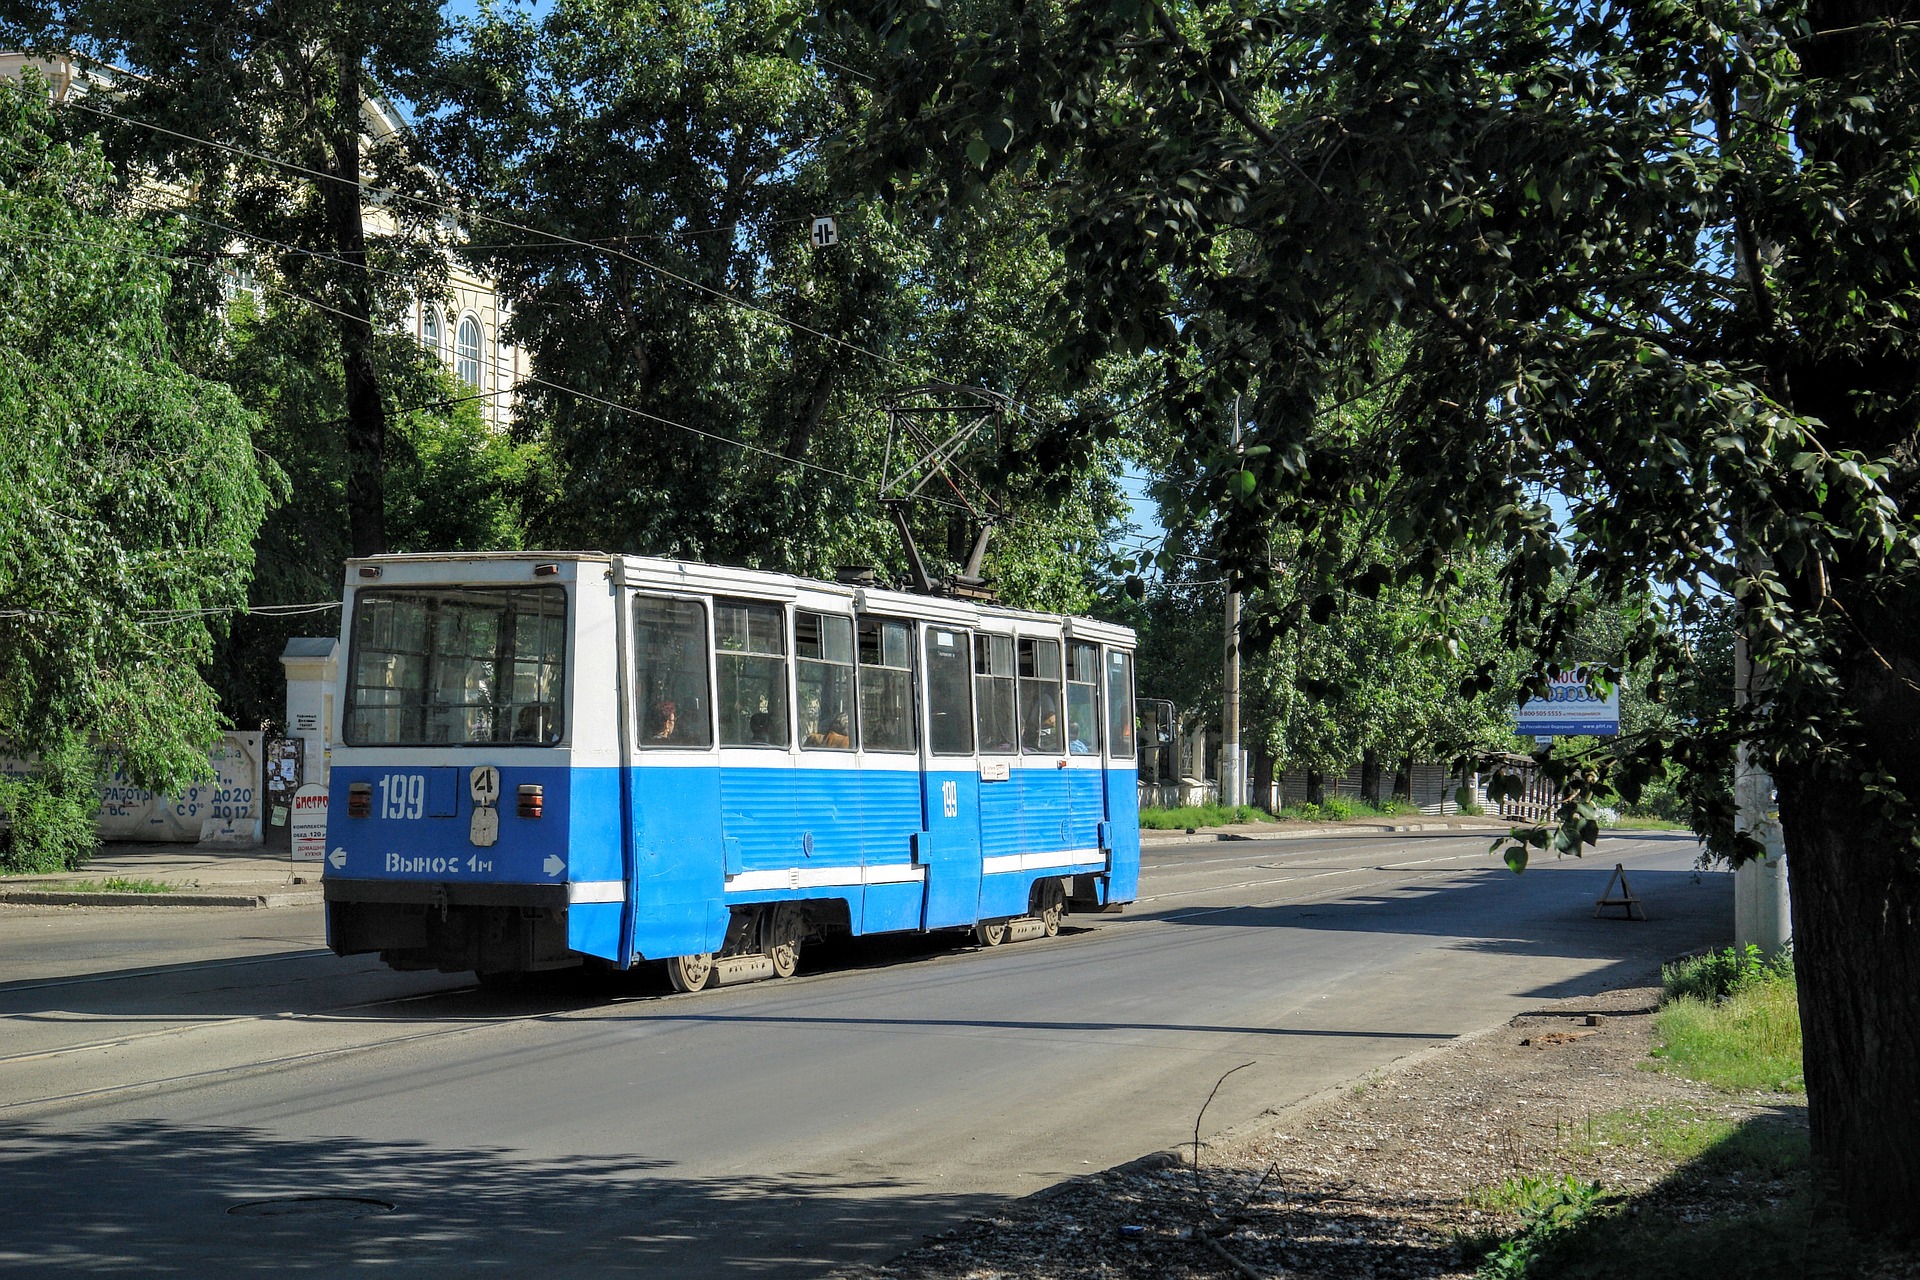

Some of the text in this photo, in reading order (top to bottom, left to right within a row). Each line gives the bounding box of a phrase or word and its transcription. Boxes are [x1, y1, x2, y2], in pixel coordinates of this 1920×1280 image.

[474, 770, 492, 793] 4
[296, 796, 328, 810] БИСТРО
[378, 774, 425, 820] 199
[942, 780, 958, 818] 199
